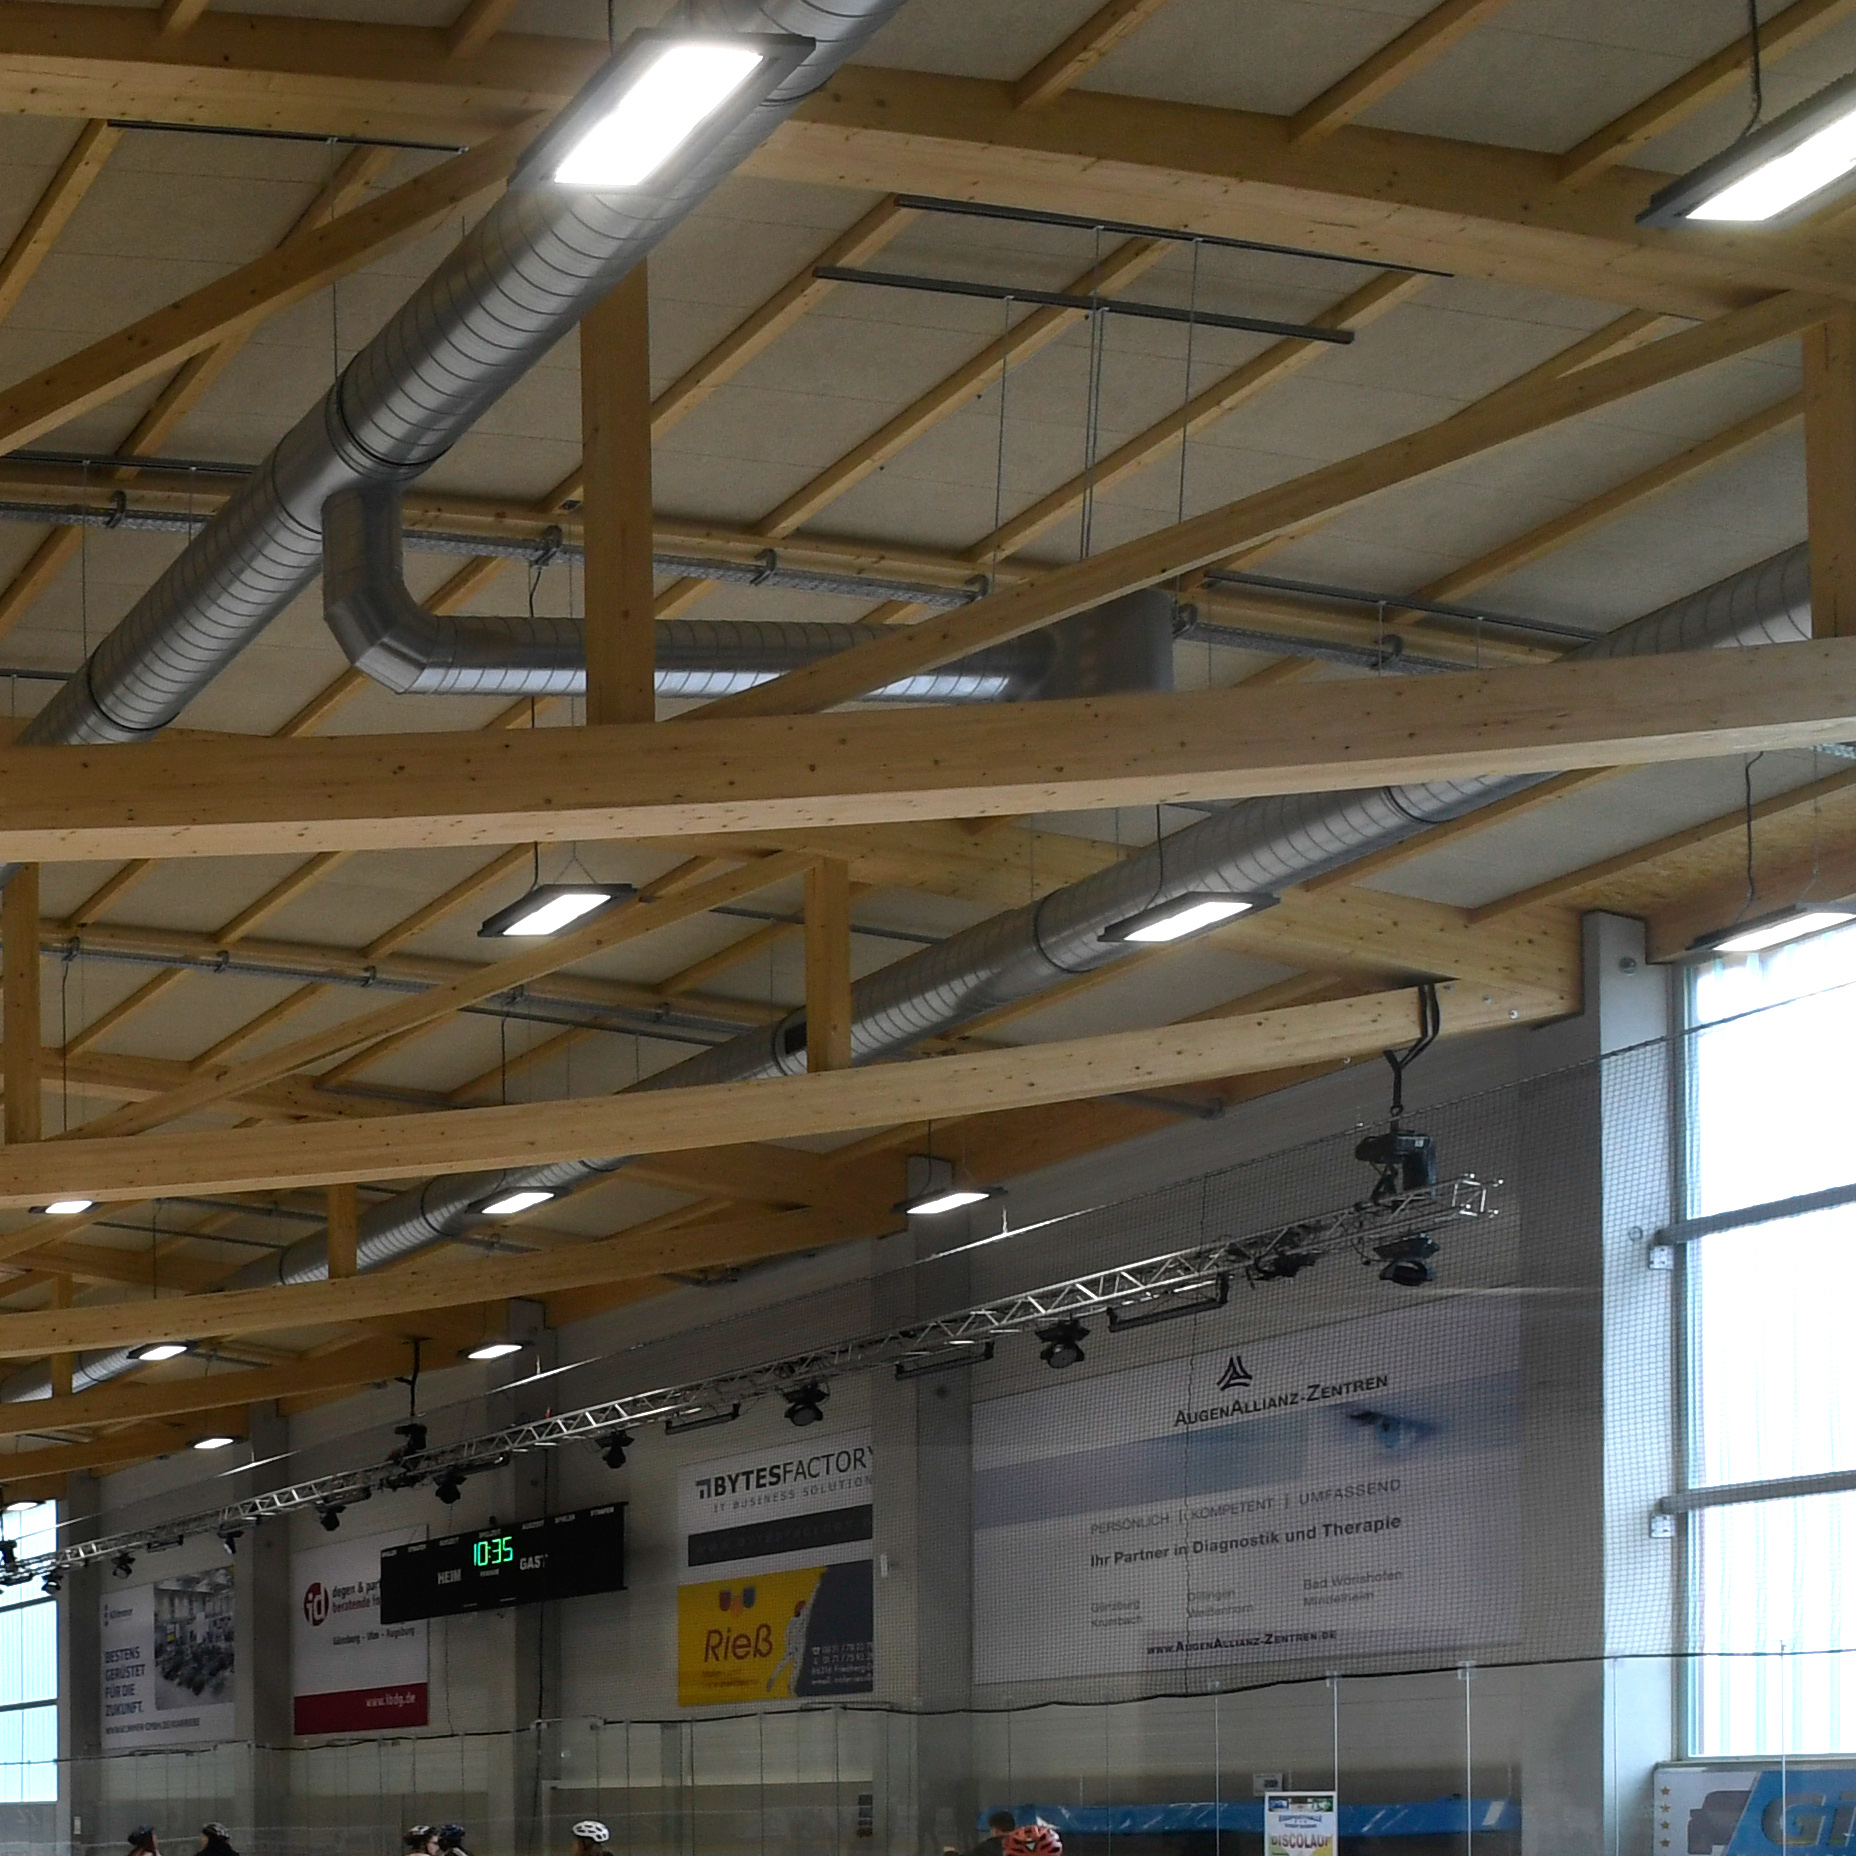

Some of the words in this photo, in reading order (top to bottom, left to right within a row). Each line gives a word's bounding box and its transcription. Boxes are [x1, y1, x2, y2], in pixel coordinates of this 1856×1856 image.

[1174, 1375, 1389, 1428] AUGENALLIANZ-ZENTREN
[474, 1536, 514, 1567] 10:35
[1090, 1554, 1110, 1567] Ihr
[1114, 1547, 1169, 1565] Partner
[1192, 1532, 1279, 1554] Diagnostik
[1285, 1526, 1317, 1543] und
[1322, 1515, 1402, 1537] Therapie
[438, 1569, 462, 1585] HEIM
[1303, 1577, 1328, 1590] Bad
[704, 1623, 773, 1663] Rieß
